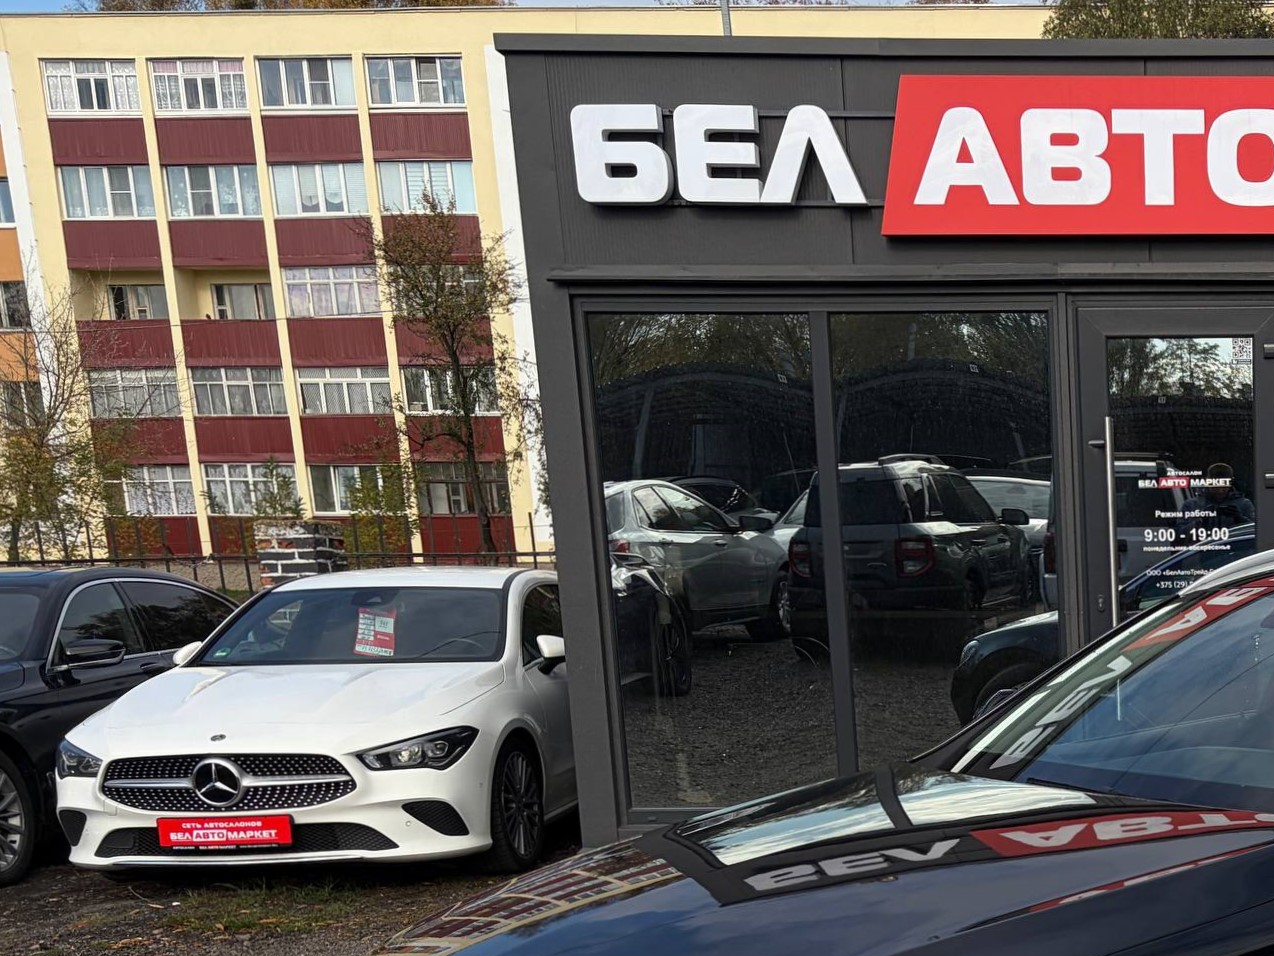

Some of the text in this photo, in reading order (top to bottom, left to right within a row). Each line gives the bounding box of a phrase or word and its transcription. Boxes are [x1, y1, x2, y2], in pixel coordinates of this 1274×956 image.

[570, 103, 869, 205] БЕЛ
[1138, 478, 1231, 488] БЕЛ АВТО МАРКЕТ
[1155, 510, 1217, 519] Режим работы
[1144, 528, 1176, 542] 9:00
[1189, 527, 1229, 541] 19:00
[1156, 581, 1173, 589] +375
[1173, 580, 1188, 589] (29)
[203, 820, 263, 829] АВТОСАЛОНОВ
[169, 829, 278, 841] БЕЛ АВТО МАРКЕТ
